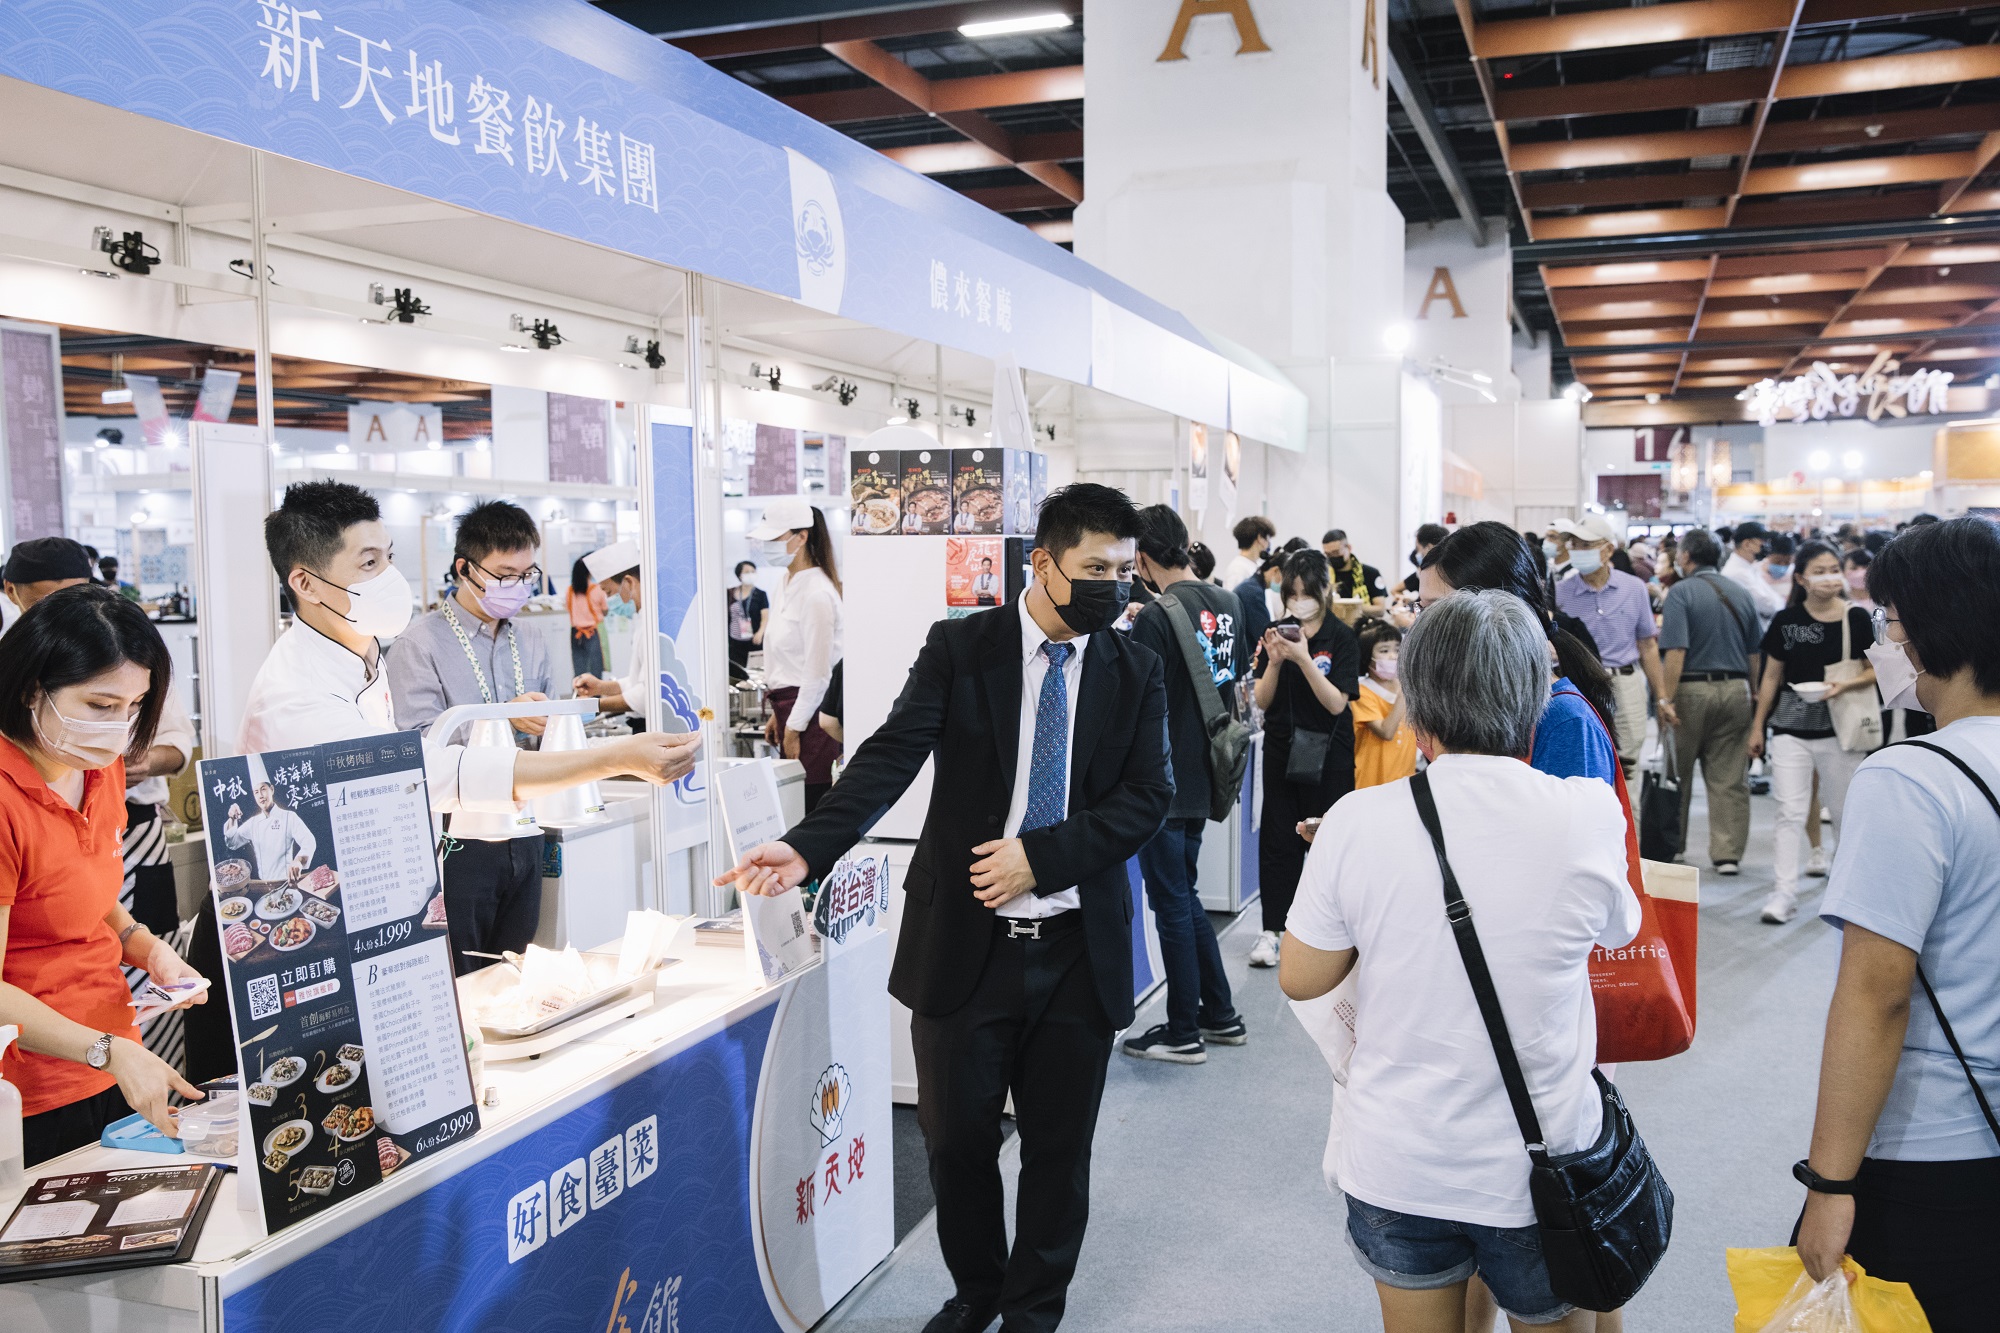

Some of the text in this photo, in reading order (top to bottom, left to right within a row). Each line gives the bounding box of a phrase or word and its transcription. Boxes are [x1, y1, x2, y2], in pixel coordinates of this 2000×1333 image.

[1155, 0, 1273, 62] A
[256, 0, 660, 214] 新天地餐飲集團
[929, 258, 1013, 334] 儂來餐廳
[1415, 266, 1469, 320] A
[366, 414, 387, 442] A
[414, 415, 430, 442] A
[273, 759, 315, 786] 烤海鮮
[326, 751, 375, 770] 中秋烤肉組
[213, 775, 248, 804] 中秋
[334, 786, 348, 808] A
[830, 865, 877, 921] 挺台灣
[374, 920, 412, 949] $1,999
[1593, 944, 1668, 962] TRaffic
[280, 956, 337, 988] 立即訂購
[366, 963, 378, 986] B
[312, 1050, 327, 1083] 2
[294, 1092, 308, 1121] 3
[435, 1111, 474, 1145] $2,999
[512, 1123, 656, 1254] 好食臺菜
[795, 1132, 865, 1226] 新天地
